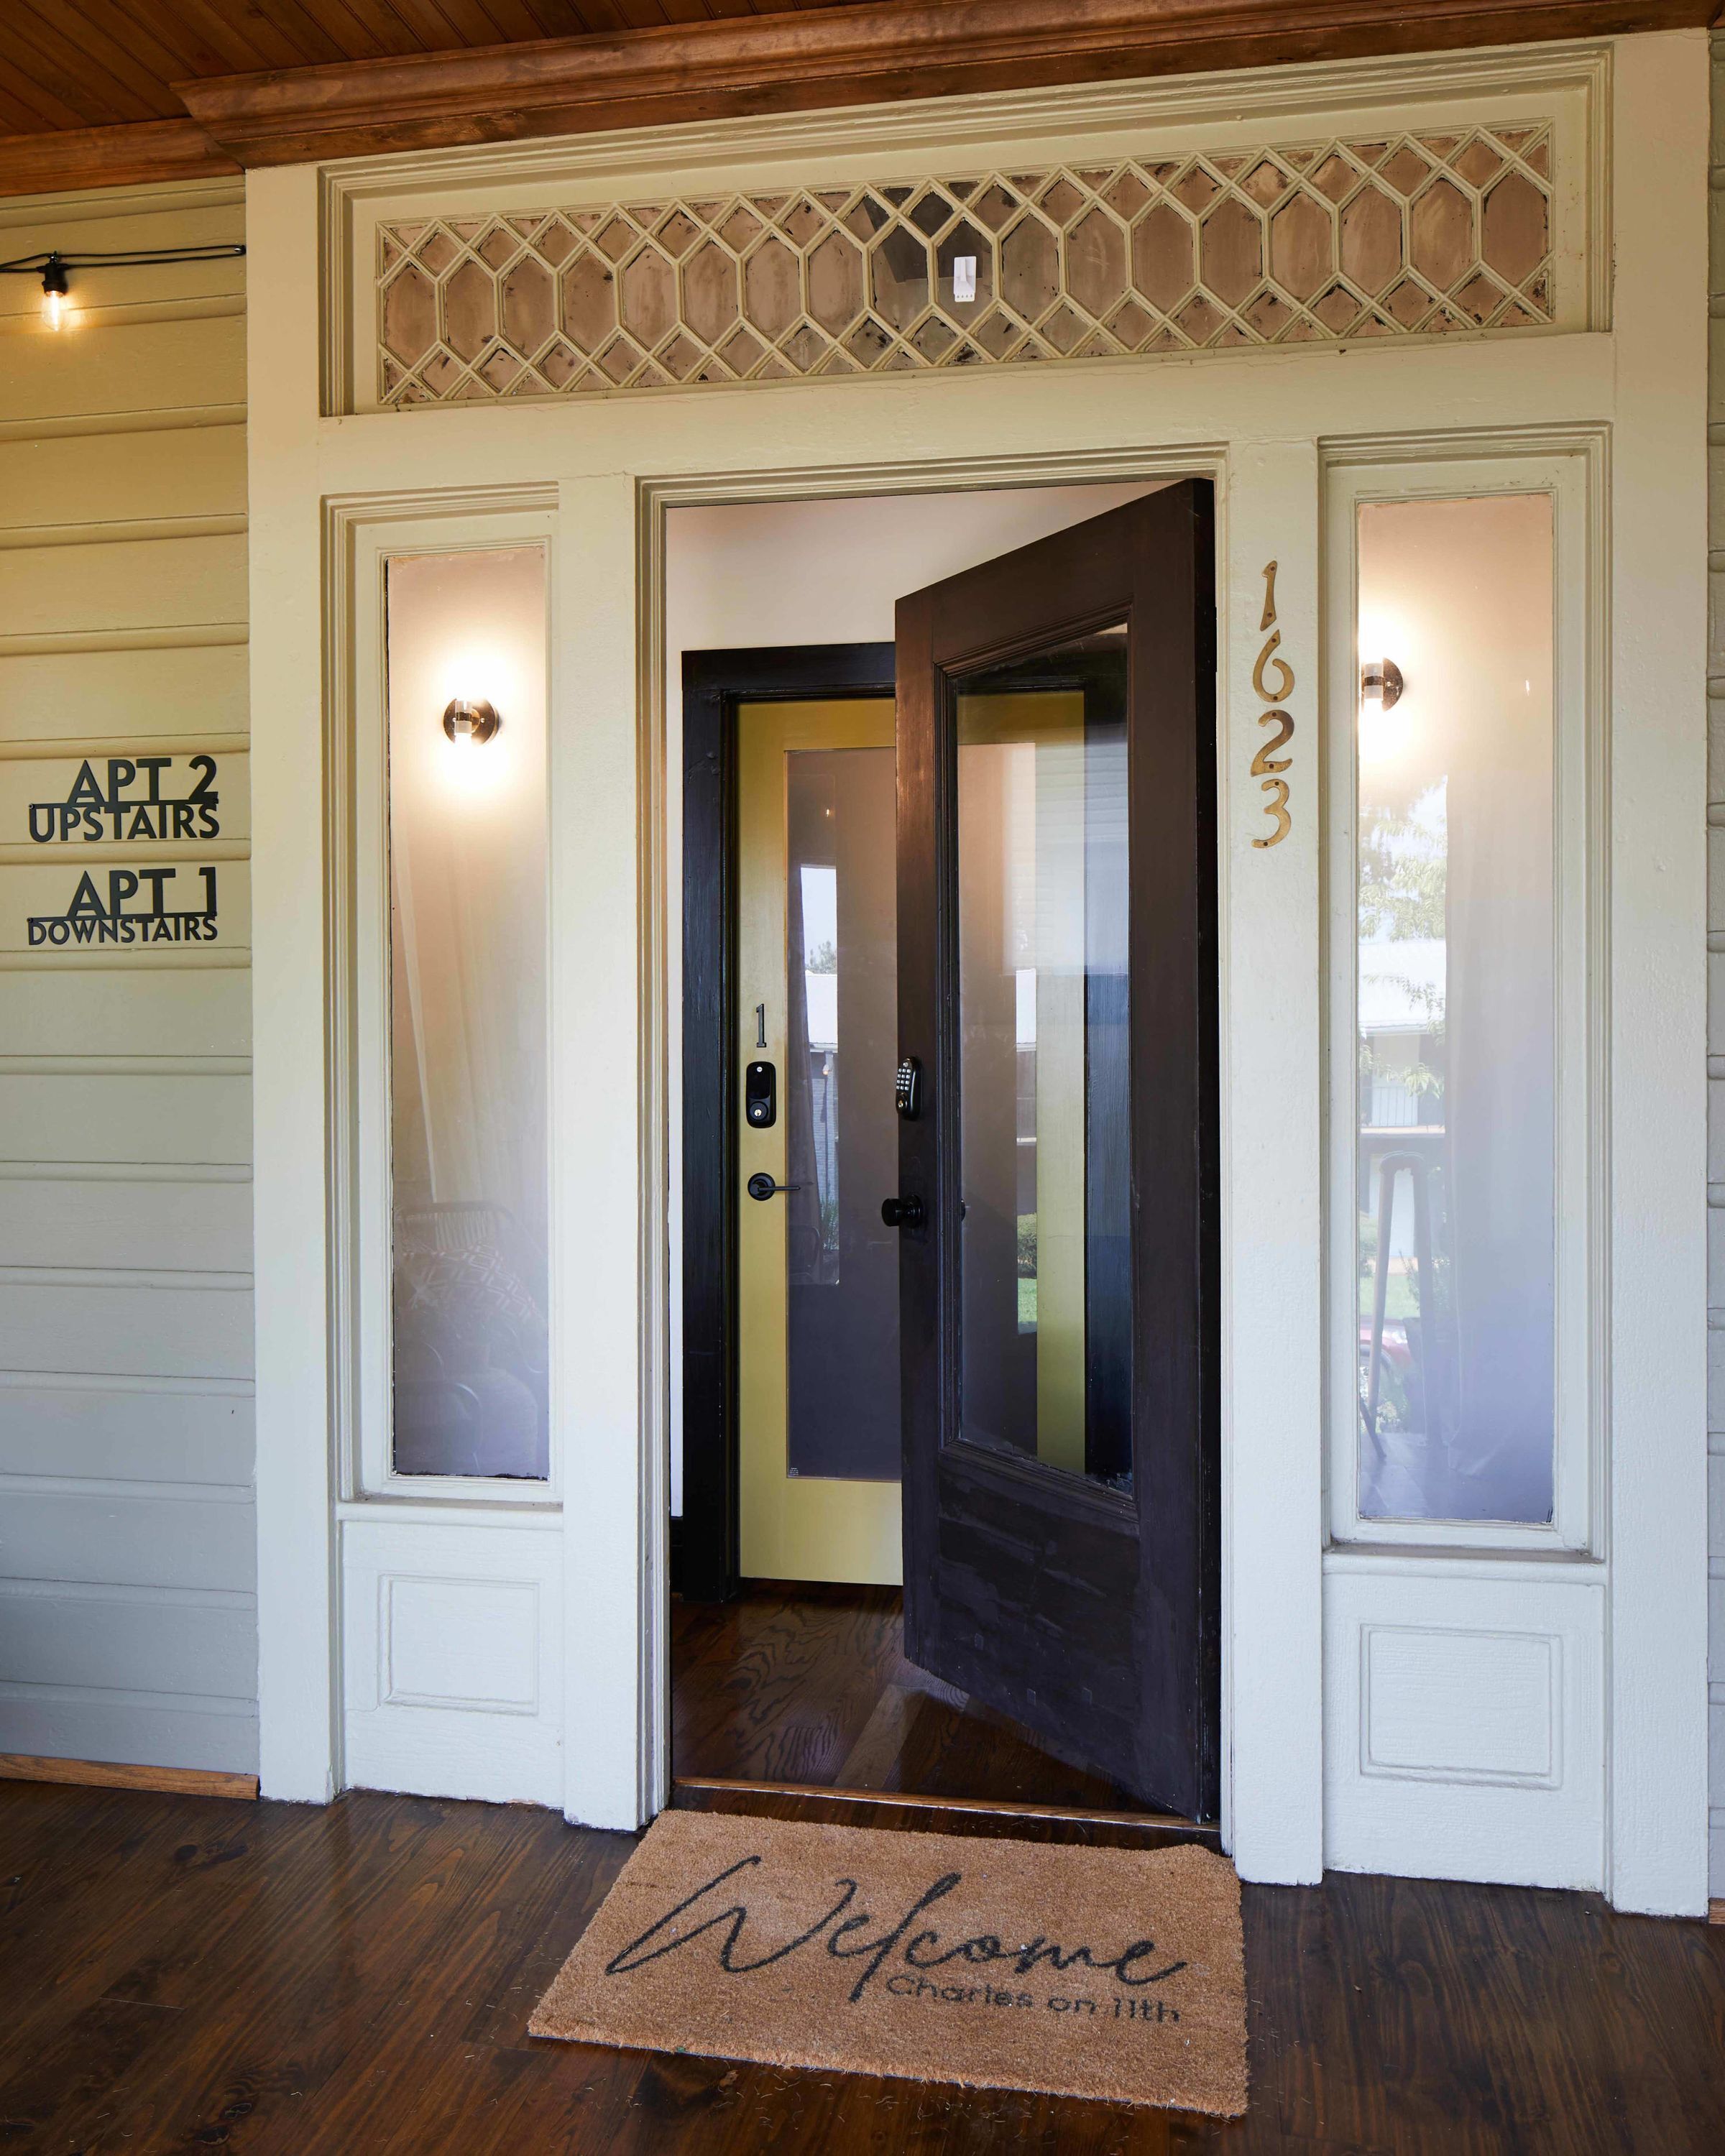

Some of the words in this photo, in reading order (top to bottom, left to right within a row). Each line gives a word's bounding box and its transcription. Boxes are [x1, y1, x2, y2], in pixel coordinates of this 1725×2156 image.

[1251, 560, 1295, 849] 1623
[67, 757, 172, 804] APT
[188, 755, 218, 803] 2
[29, 803, 220, 843] UPSTAIRS
[66, 868, 176, 917] APT
[198, 867, 217, 915] 1
[27, 918, 218, 946] DOWNSTAIRS
[755, 1003, 767, 1048] 1
[604, 1854, 1187, 2003] Welcome
[886, 1974, 1034, 2009] Charles
[1047, 1996, 1097, 2014] on
[1113, 1996, 1181, 2024] 11th
